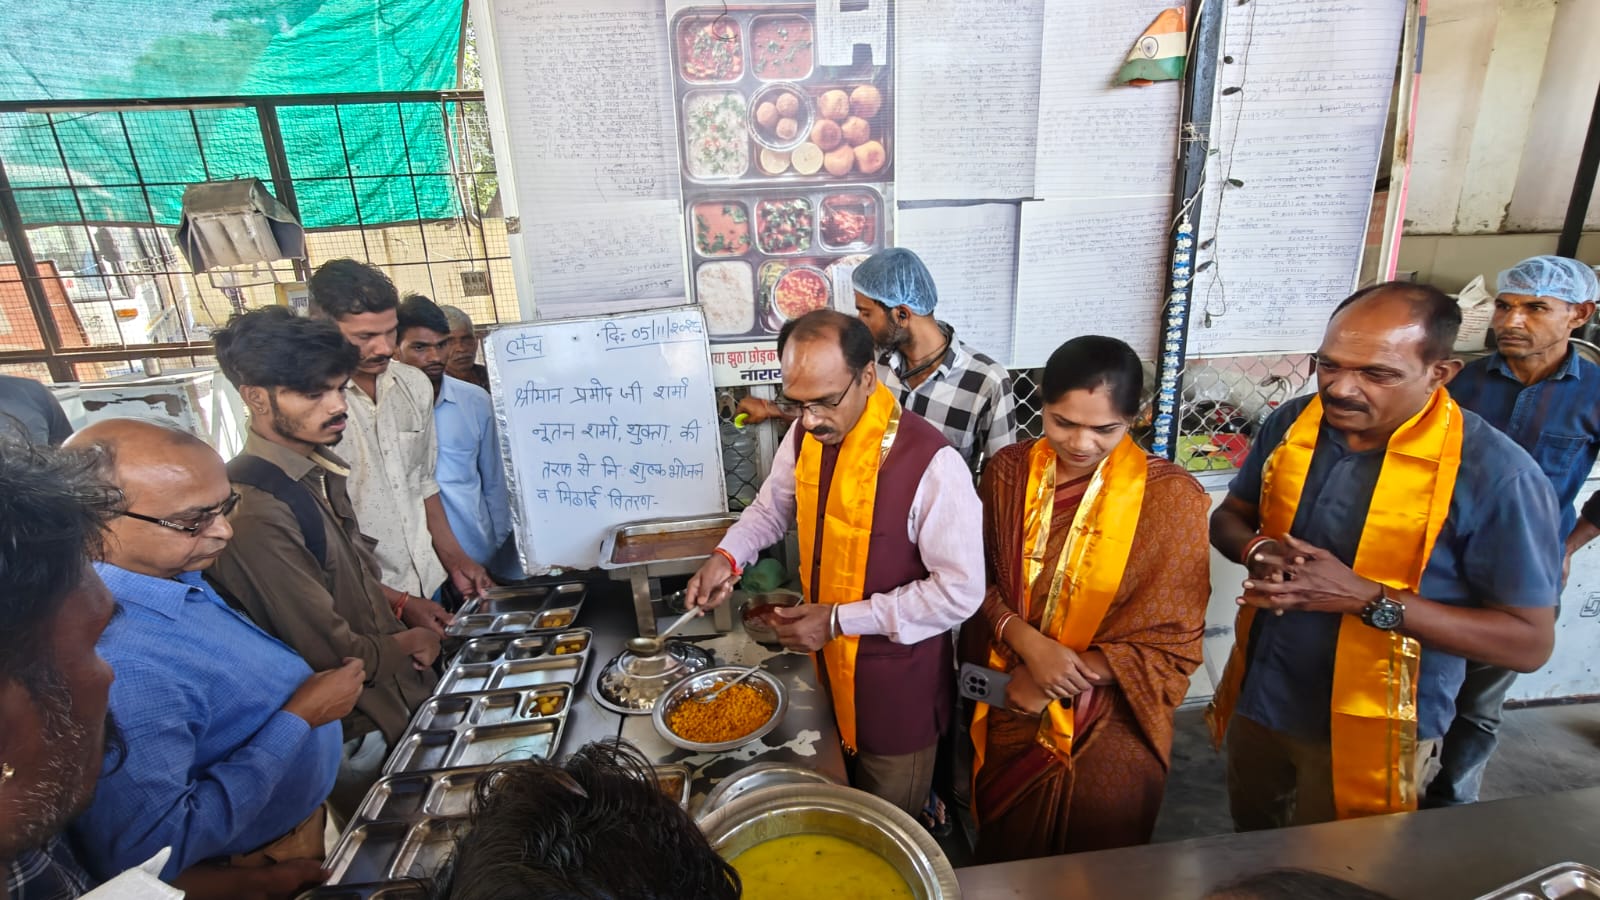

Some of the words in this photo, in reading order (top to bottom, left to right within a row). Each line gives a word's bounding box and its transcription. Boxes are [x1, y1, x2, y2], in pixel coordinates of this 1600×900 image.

[514, 380, 563, 408] श्रीमान
[569, 378, 614, 405] प्रमोद
[619, 380, 644, 405] जी
[653, 377, 689, 401] शर्मा
[532, 423, 576, 444] नूतन
[679, 418, 703, 443] की
[542, 461, 573, 479] तरफ
[577, 453, 597, 477] से
[668, 457, 704, 480] भोजन
[536, 488, 549, 500] व
[555, 481, 602, 509] मिठाई
